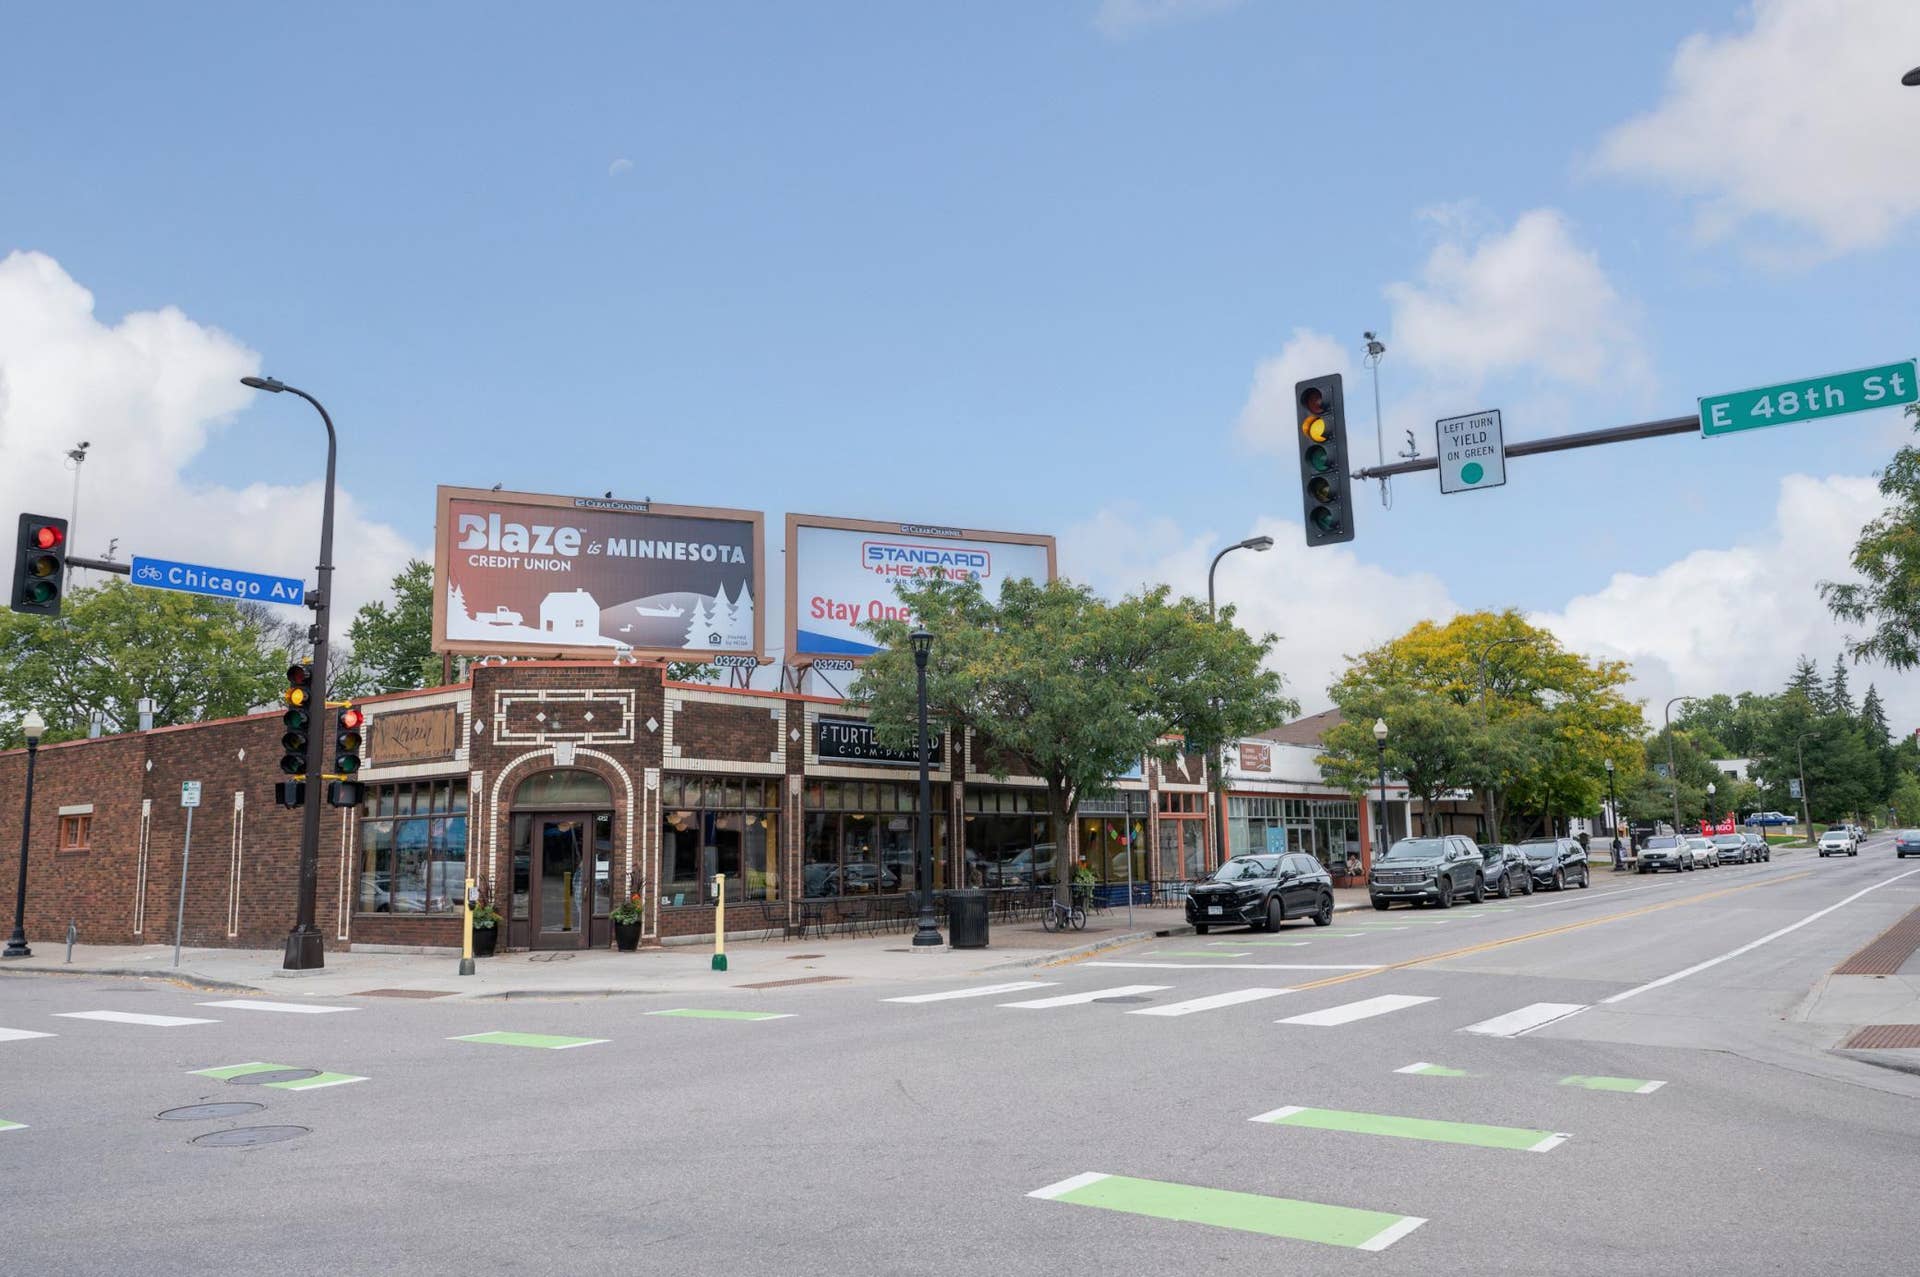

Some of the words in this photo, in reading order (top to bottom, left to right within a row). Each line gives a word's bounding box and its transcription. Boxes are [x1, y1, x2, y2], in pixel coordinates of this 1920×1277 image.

[1710, 402, 1733, 428] E
[1750, 384, 1846, 419] 48th
[1862, 372, 1906, 402] St
[1443, 422, 1465, 434] LEFT
[1469, 416, 1494, 430] TURN
[1452, 431, 1487, 447] YIELD
[1447, 451, 1460, 462] ON
[1464, 445, 1495, 459] GREEN
[458, 512, 582, 557] Blaze
[586, 540, 602, 555] is
[606, 537, 746, 564] MINNESOTA
[468, 554, 520, 569] CREDIT
[524, 557, 571, 572] UNION
[868, 546, 985, 567] STANDARD
[168, 567, 261, 598] Chicago
[270, 581, 300, 600] Av
[811, 596, 860, 627] Stay
[867, 599, 911, 624] One
[715, 655, 757, 668] 032720
[813, 659, 853, 671] 032750
